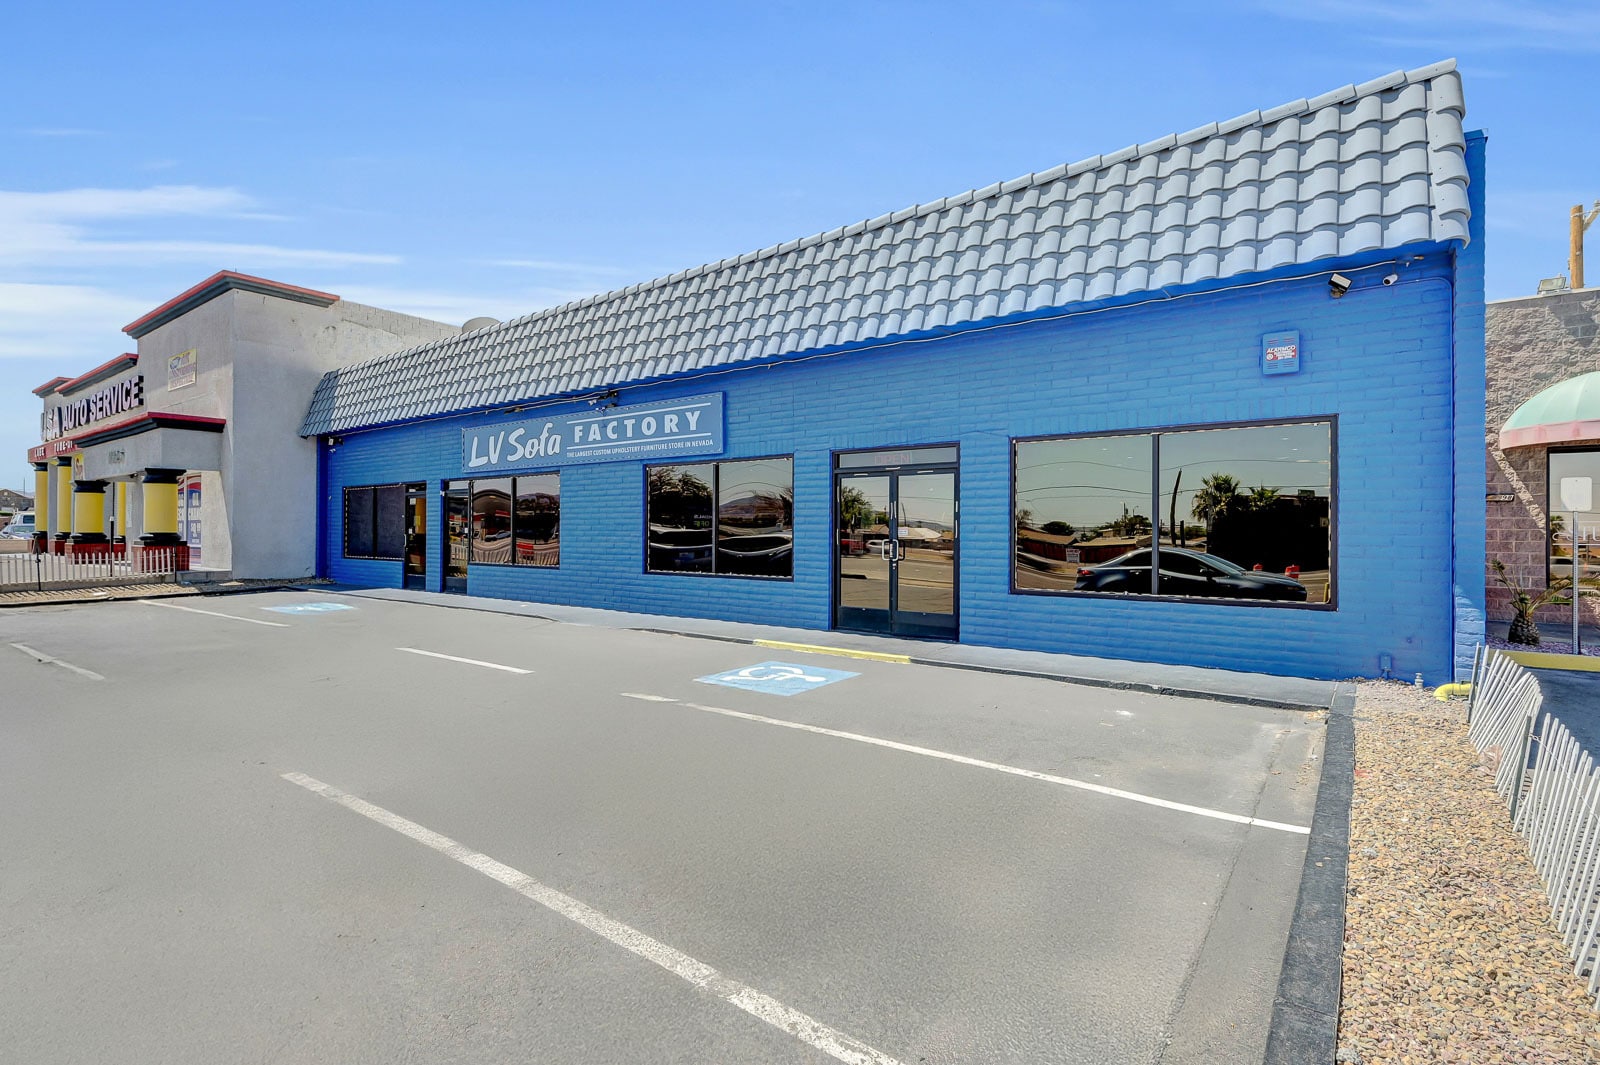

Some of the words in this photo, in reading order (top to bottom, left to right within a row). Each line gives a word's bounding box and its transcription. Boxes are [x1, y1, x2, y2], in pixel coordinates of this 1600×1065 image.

[41, 407, 61, 441] USA
[62, 398, 87, 432] AUTO
[89, 376, 141, 421] SERVICE
[468, 431, 505, 468] LV
[507, 422, 561, 462] Sofa
[574, 411, 701, 443] FACTORY
[593, 448, 611, 456] CUSTOM
[612, 446, 641, 454] UPHOLSTERY
[641, 443, 668, 452] FURNITURE
[669, 441, 684, 449] STORE
[692, 439, 714, 447] NEVADA
